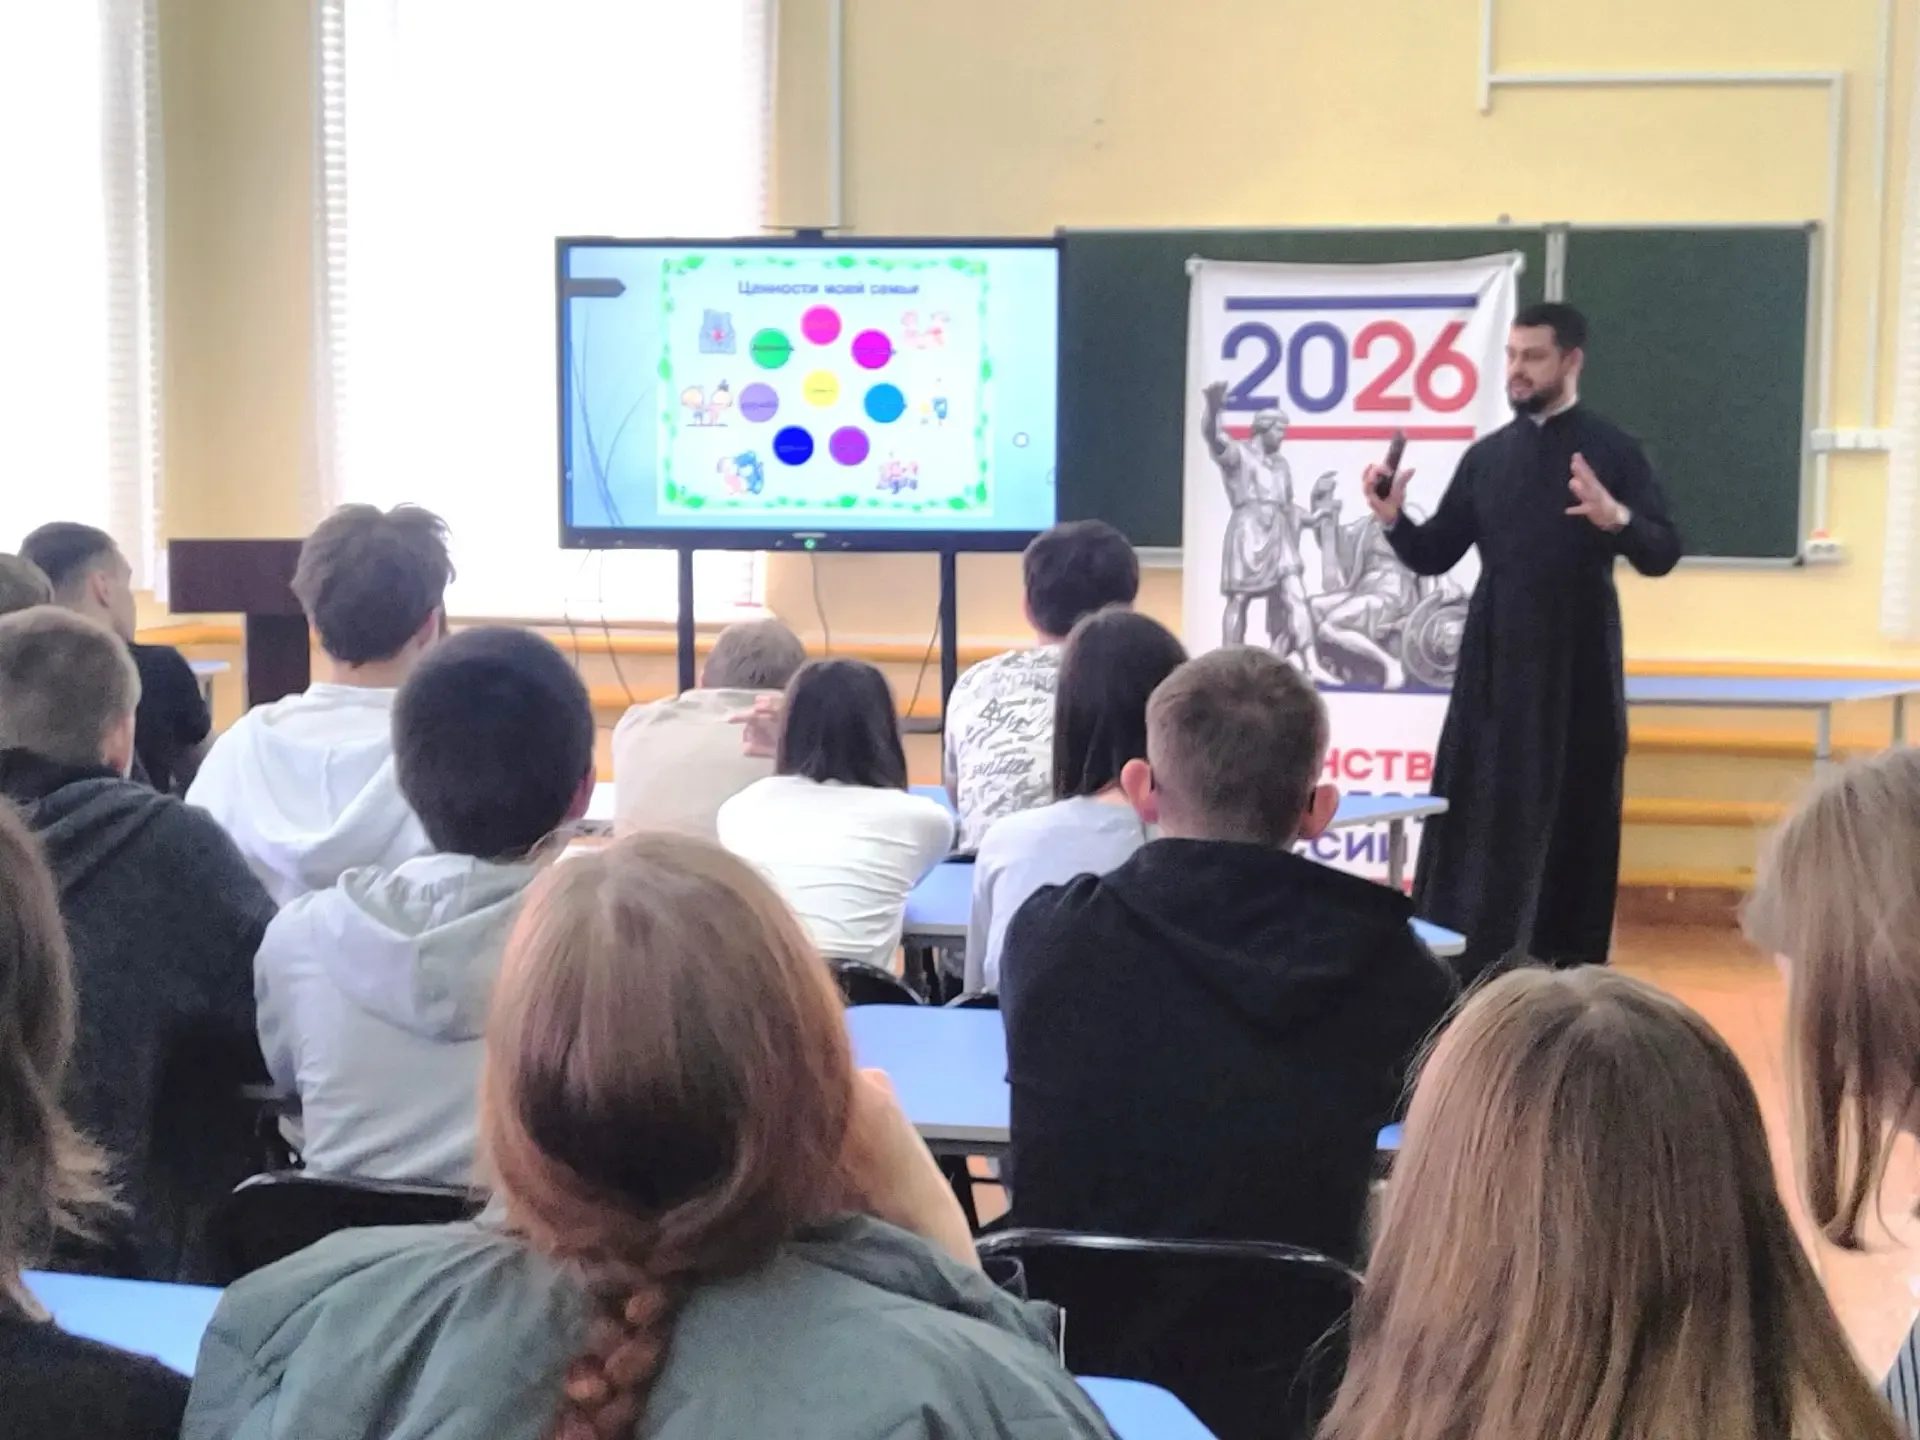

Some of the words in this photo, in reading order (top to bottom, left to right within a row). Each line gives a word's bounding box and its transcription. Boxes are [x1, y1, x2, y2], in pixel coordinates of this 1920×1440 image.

[738, 280, 819, 296] Ценности
[1220, 320, 1479, 413] 2026
[1324, 748, 1433, 782] НСТВ
